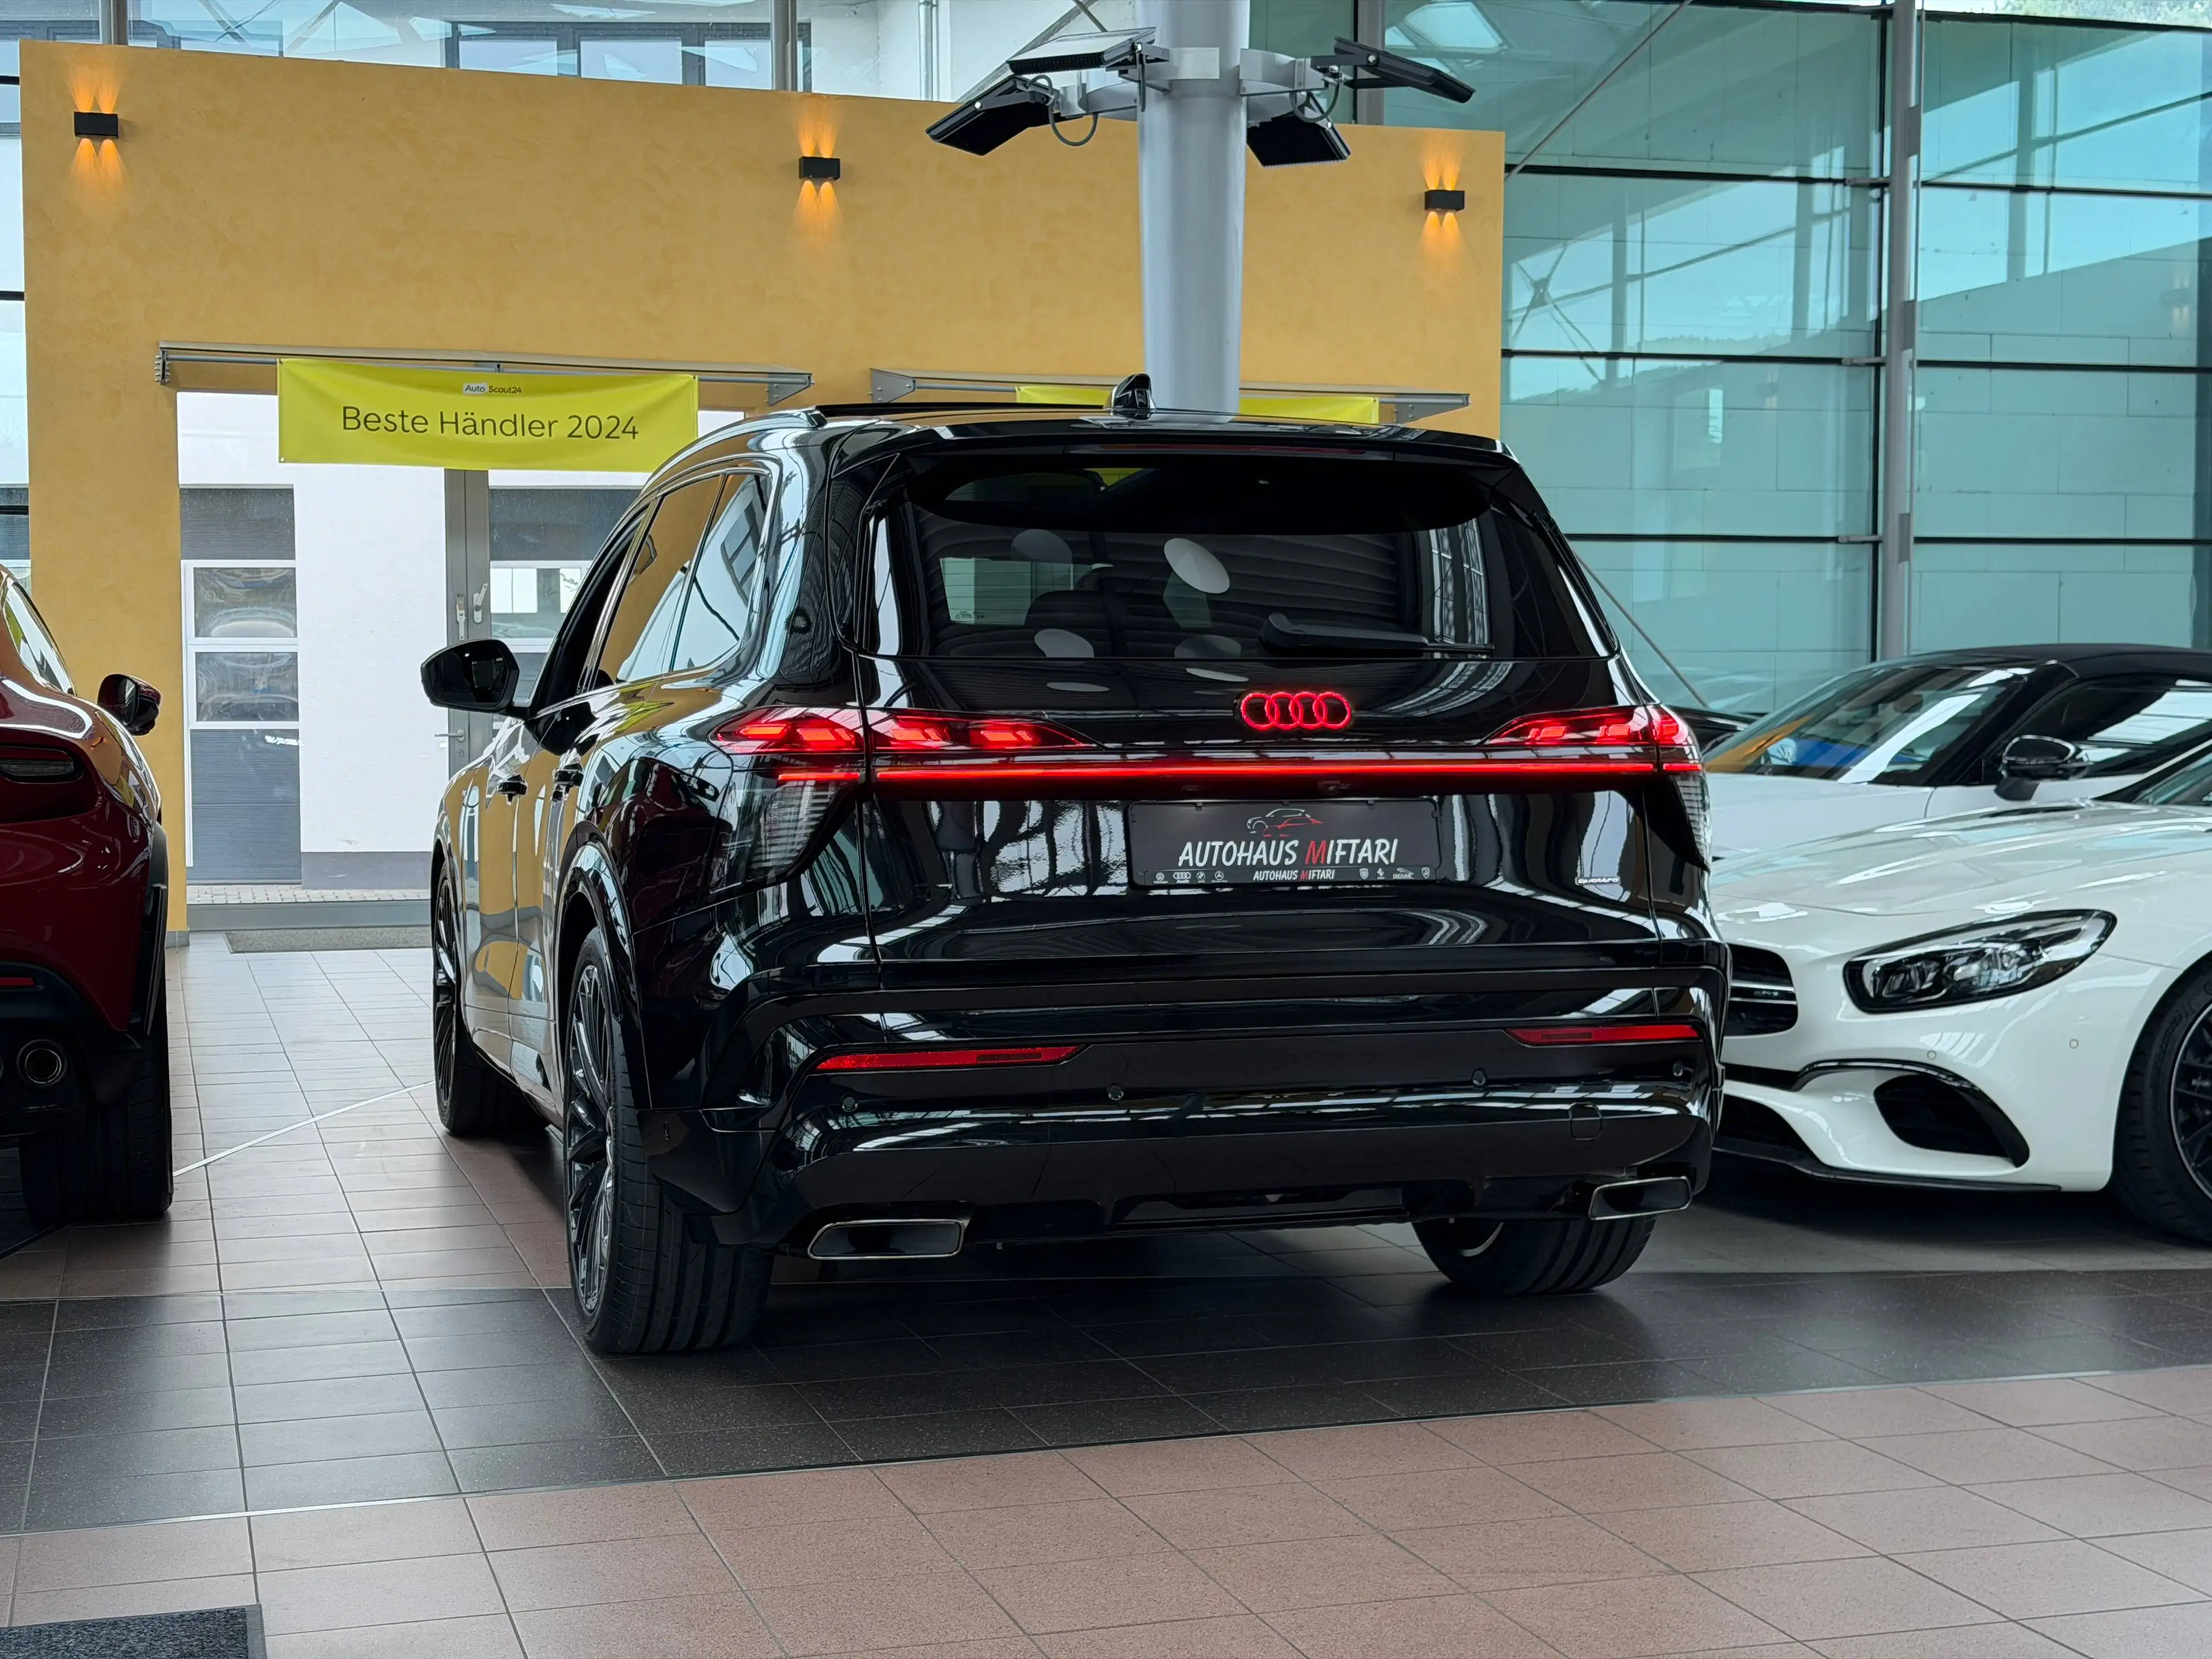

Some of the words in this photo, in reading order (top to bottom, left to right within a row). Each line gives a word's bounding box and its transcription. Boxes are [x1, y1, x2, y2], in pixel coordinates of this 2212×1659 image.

[343, 406, 429, 433] Beste
[440, 411, 559, 438] Händler
[567, 415, 639, 440] 2024
[1178, 840, 1299, 866] AUTOHAUS
[1305, 839, 1398, 865] MIFTARI
[1253, 870, 1298, 881] AUTOHAUS
[1300, 869, 1335, 880] MIFTARI
